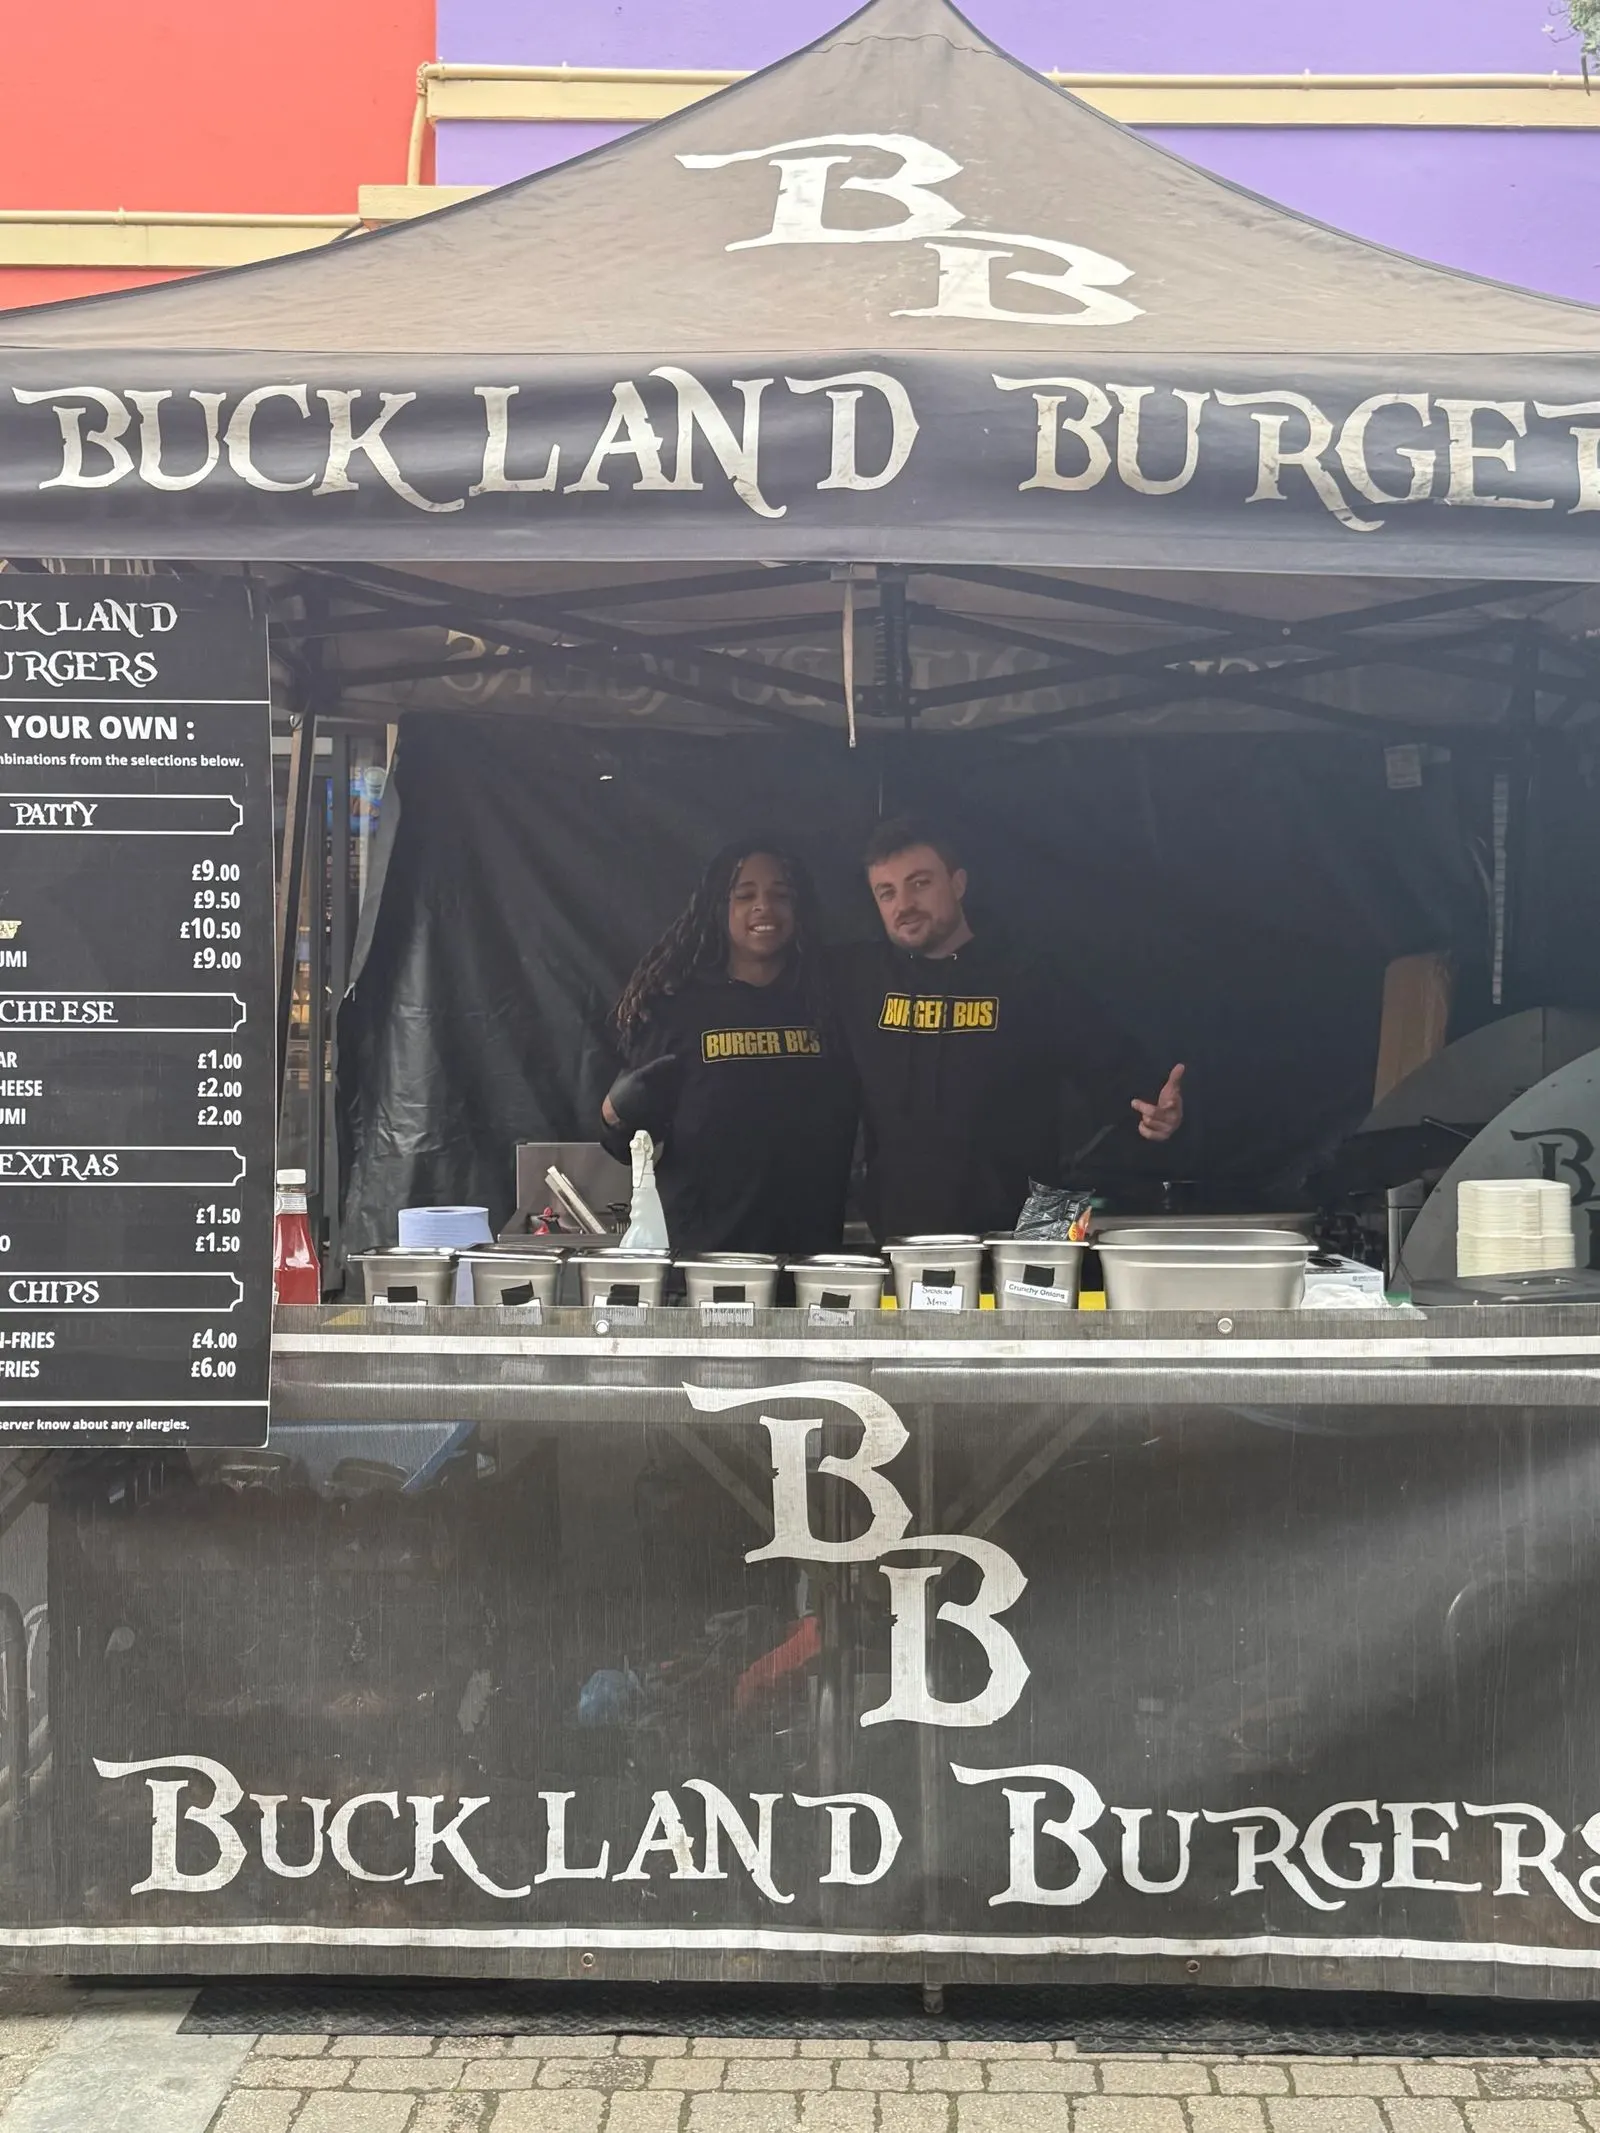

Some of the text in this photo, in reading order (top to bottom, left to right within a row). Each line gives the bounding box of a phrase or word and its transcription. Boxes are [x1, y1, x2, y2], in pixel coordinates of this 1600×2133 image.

[4, 715, 92, 739] YOUR
[100, 716, 177, 739] OWN
[70, 754, 102, 765] from
[105, 754, 128, 765] the
[131, 754, 197, 766] selections
[201, 755, 243, 767] below.
[10, 801, 98, 827] PATTY
[192, 860, 240, 881] £9.00
[194, 890, 240, 909] £9.50
[180, 917, 240, 939] £10.50
[194, 948, 241, 969] £9.00
[0, 1000, 118, 1023] CHEESE
[884, 998, 993, 1028] BURGER BUS
[706, 1030, 821, 1058] BURGER BUS
[198, 1050, 242, 1069] £1.00
[198, 1078, 242, 1097] £2.00
[198, 1106, 242, 1125] £2.00
[0, 1152, 119, 1180] EXTRAS
[196, 1205, 240, 1224] £1.50
[196, 1232, 240, 1252] £1.50
[9, 1280, 99, 1303] CHIPS
[1008, 1283, 1066, 1300] Crunchy Onions
[192, 1329, 237, 1348] £4.00
[191, 1357, 236, 1377] £6.00
[37, 1419, 70, 1430] know
[73, 1419, 108, 1429] about
[111, 1421, 133, 1432] any
[136, 1419, 189, 1432] allergies.
